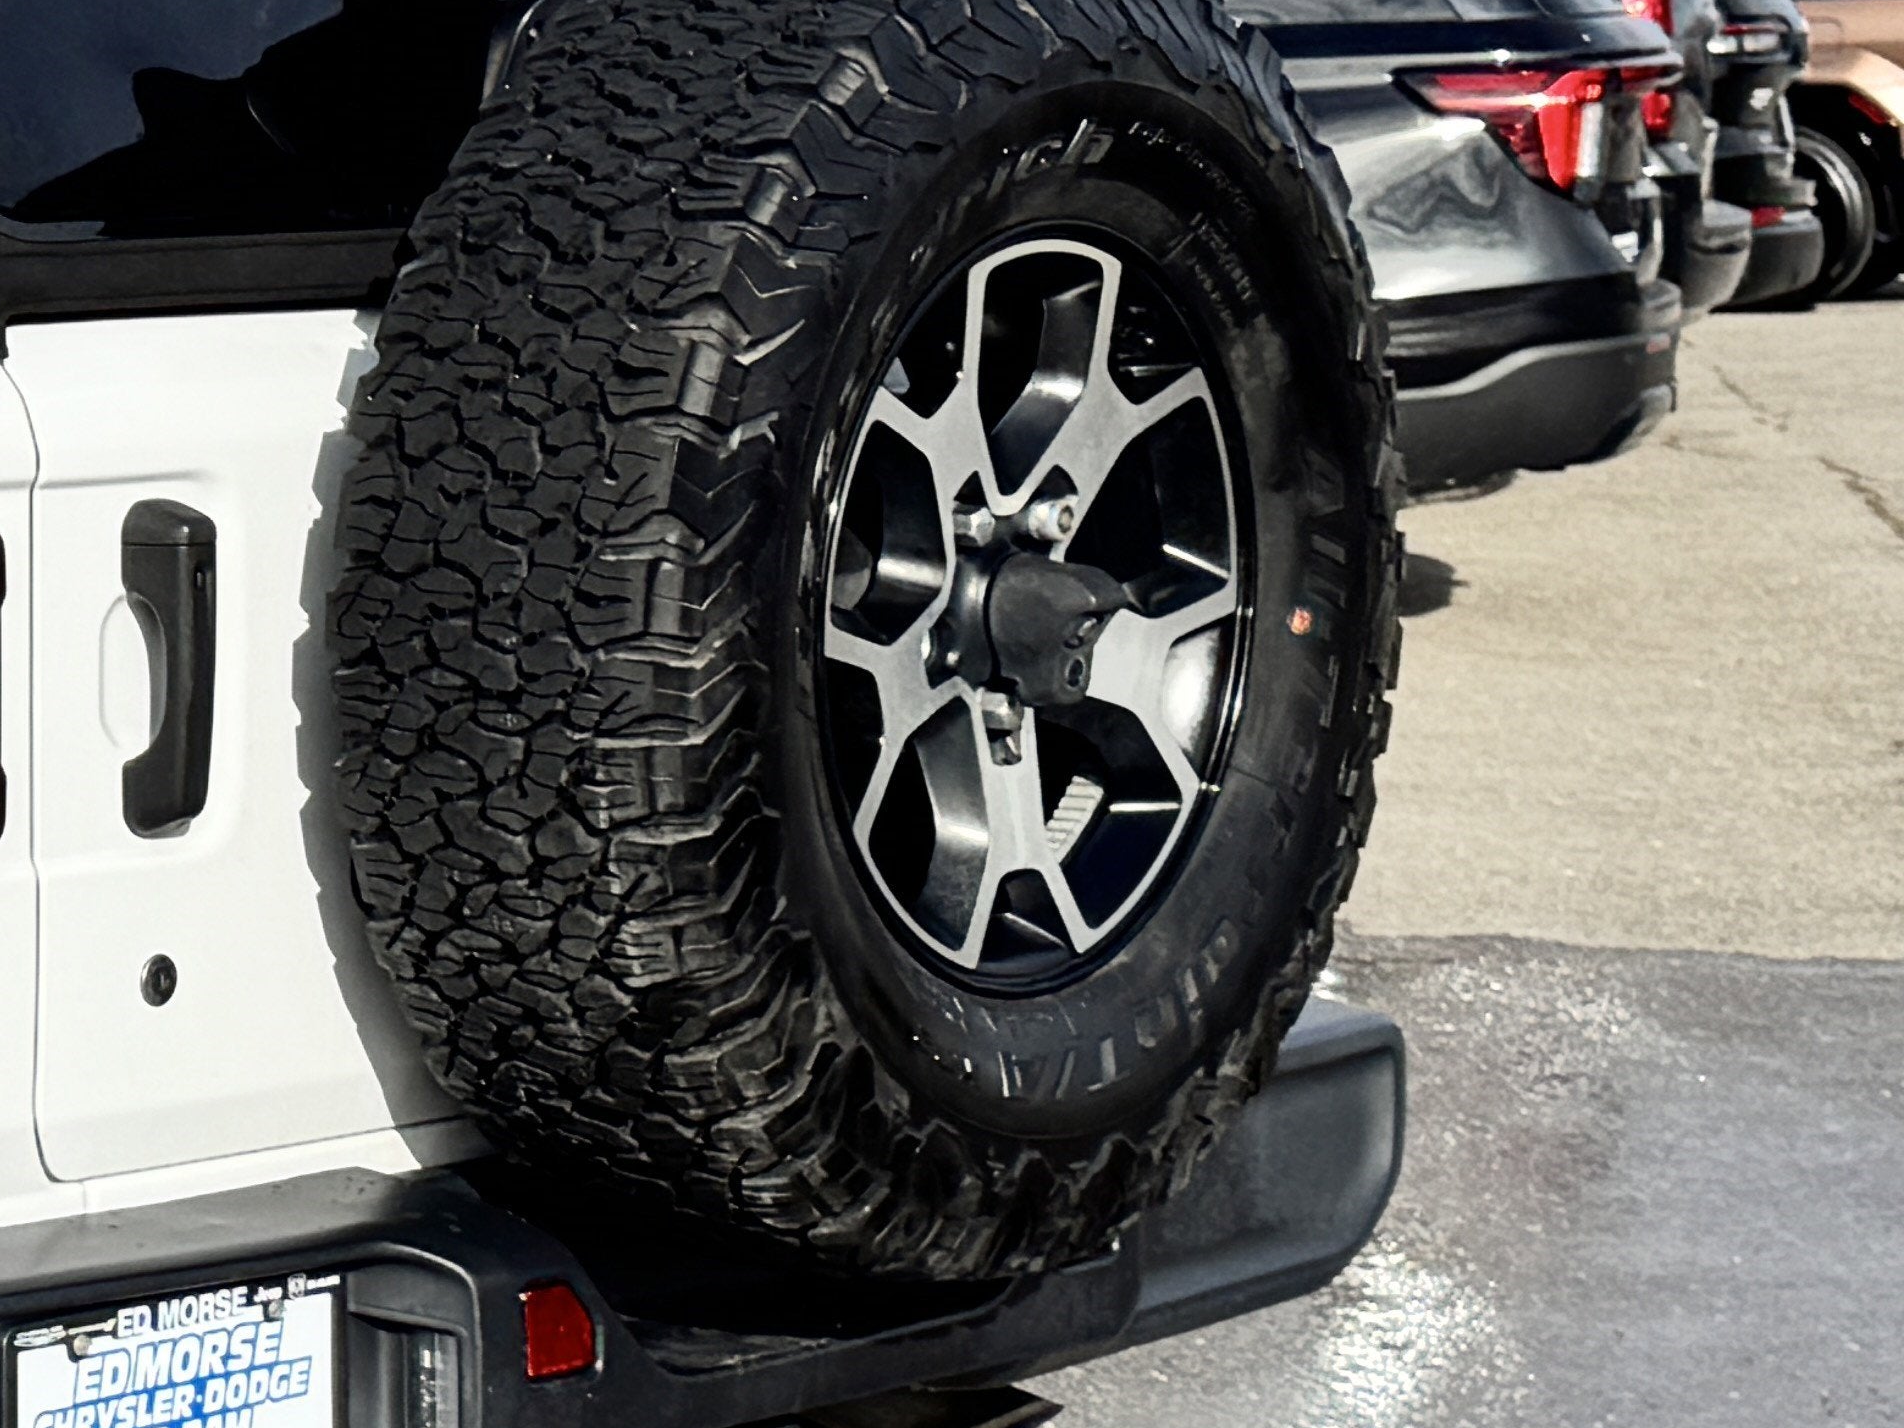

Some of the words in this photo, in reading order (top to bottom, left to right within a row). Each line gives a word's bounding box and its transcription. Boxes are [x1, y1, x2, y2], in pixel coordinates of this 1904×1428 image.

[115, 1304, 153, 1339] ED
[157, 1284, 249, 1331] MORSE
[73, 1347, 133, 1402] ED
[130, 1321, 284, 1392] MORSE
